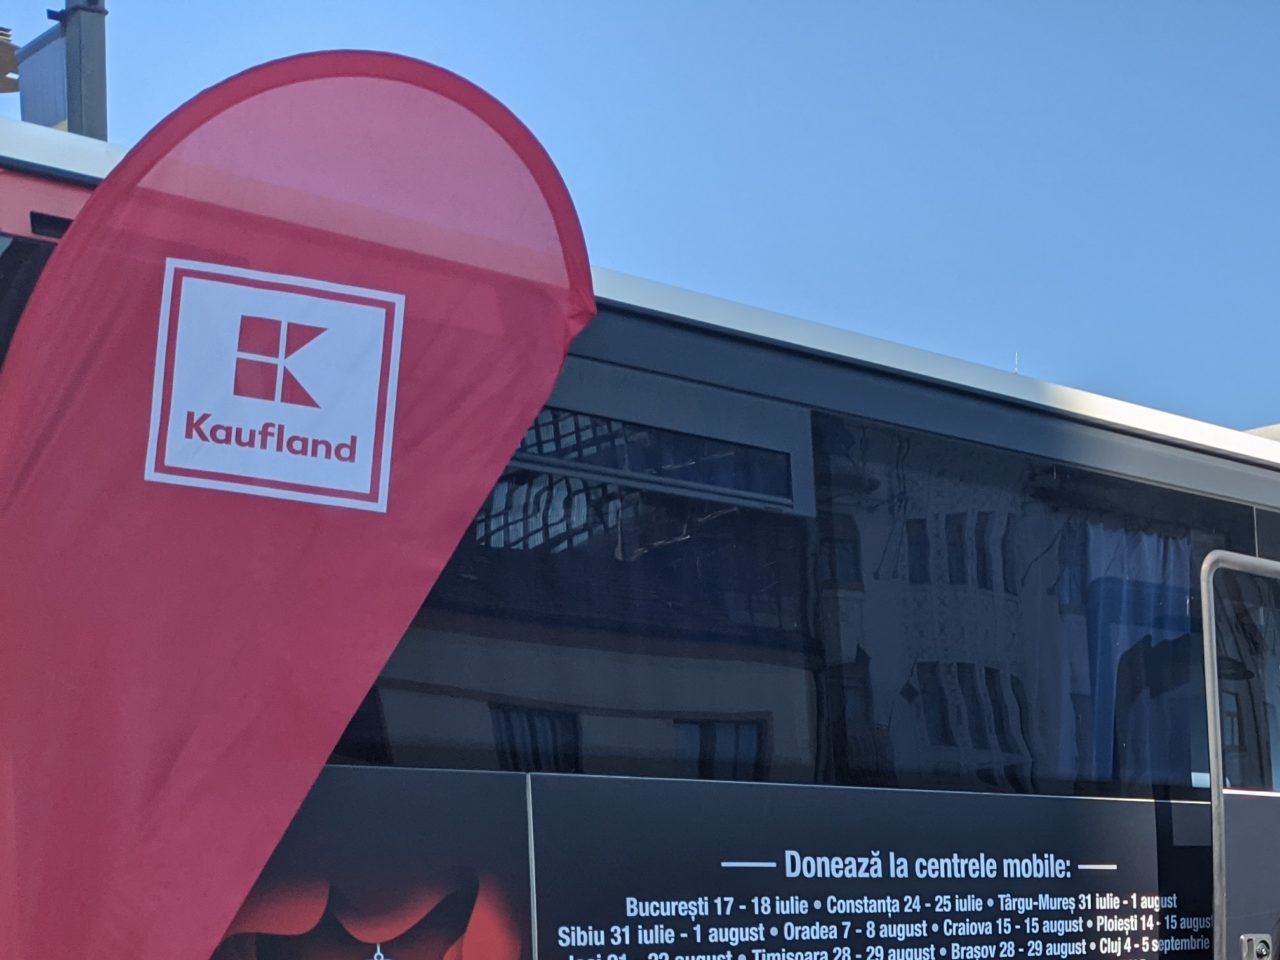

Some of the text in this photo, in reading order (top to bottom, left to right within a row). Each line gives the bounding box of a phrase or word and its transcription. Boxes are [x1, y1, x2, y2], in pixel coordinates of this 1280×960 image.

[185, 411, 357, 463] Kaufland
[785, 850, 1071, 878] Donează la centrele mobile:
[625, 897, 709, 921] București
[714, 897, 734, 915] 17
[751, 896, 770, 914] 18
[775, 896, 808, 914] iulie
[827, 895, 899, 918] Constanța
[904, 896, 921, 912] 24
[935, 895, 951, 911] 25
[955, 895, 983, 912] iulie
[998, 894, 1075, 915] Târgu-Mureș
[1079, 894, 1092, 909] 31
[1096, 893, 1120, 910] iulie
[1131, 893, 1137, 909] 1
[1141, 893, 1177, 912] august
[558, 925, 604, 947] Sibiu
[610, 925, 630, 946] 31
[638, 924, 675, 945] iulie
[693, 925, 701, 943] 1
[708, 923, 765, 945] august
[784, 922, 837, 941] Oradea
[842, 922, 851, 939] 7
[866, 922, 875, 938] 8
[880, 920, 927, 941] august
[943, 919, 992, 937] Craiova
[996, 919, 1011, 935] 15
[1025, 918, 1039, 934] 15
[1042, 918, 1083, 937] august
[1097, 915, 1137, 935] Ploiești
[1141, 915, 1154, 930] 14
[1165, 915, 1177, 929] 15
[1000, 941, 1015, 957] 28
[1028, 939, 1043, 956] 29
[1046, 938, 1086, 957] august
[1100, 937, 1121, 956] Cluj
[1124, 937, 1131, 952] 4
[1142, 937, 1149, 952] 5
[1152, 935, 1209, 954] septembrie
